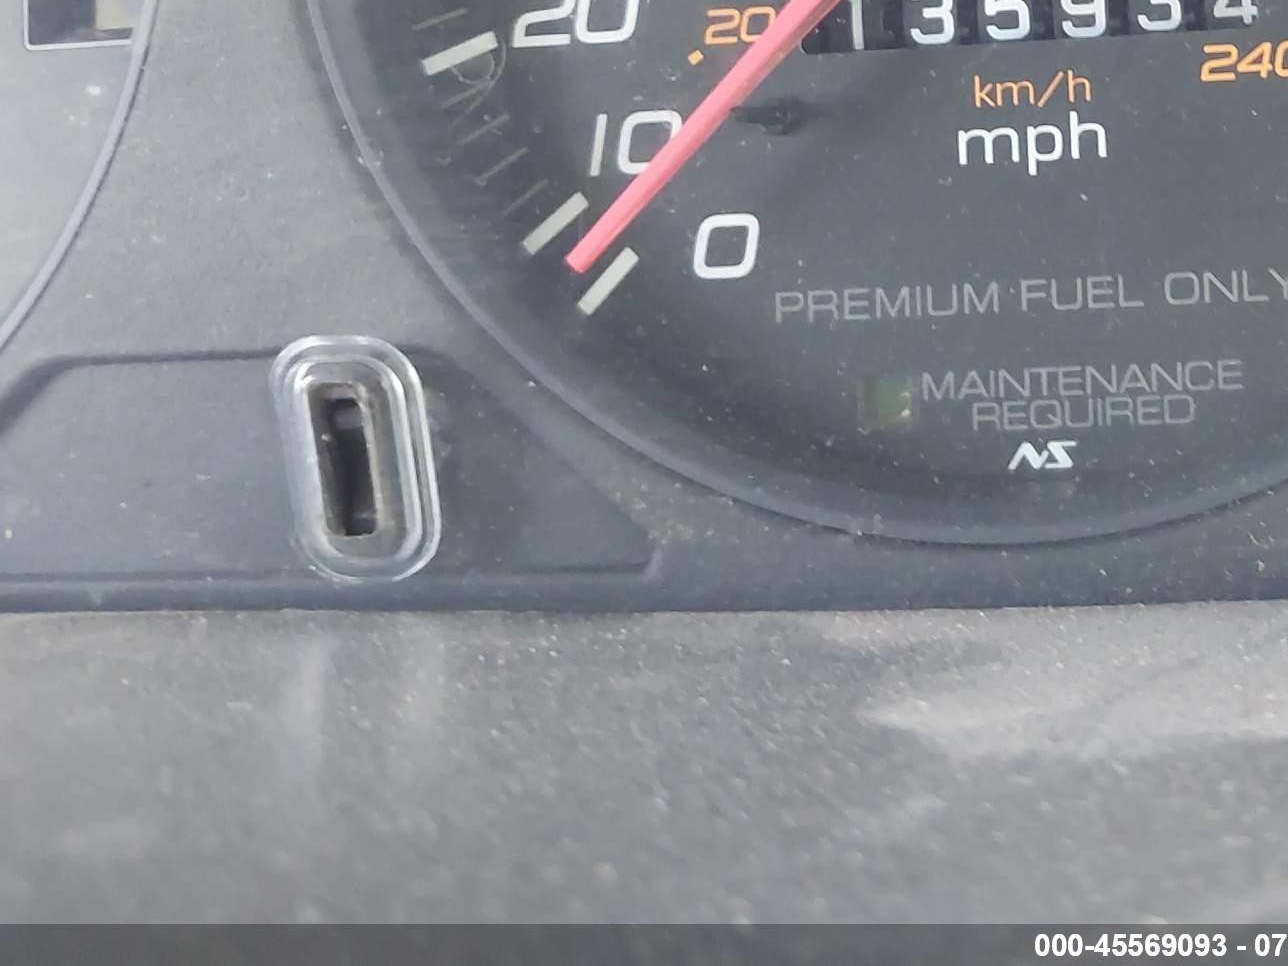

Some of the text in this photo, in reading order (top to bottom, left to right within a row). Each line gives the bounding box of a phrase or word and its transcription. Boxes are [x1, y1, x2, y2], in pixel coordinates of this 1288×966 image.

[705, 6, 777, 45] 20
[975, 70, 1090, 107] km/h
[590, 110, 684, 177] 10
[958, 111, 1107, 175] mph
[694, 214, 759, 279] 0
[775, 283, 999, 322] PREMIUM
[1020, 274, 1144, 311] FUEL
[922, 360, 1245, 400] MAINTENANCE
[972, 395, 1195, 431] REQUIRED
